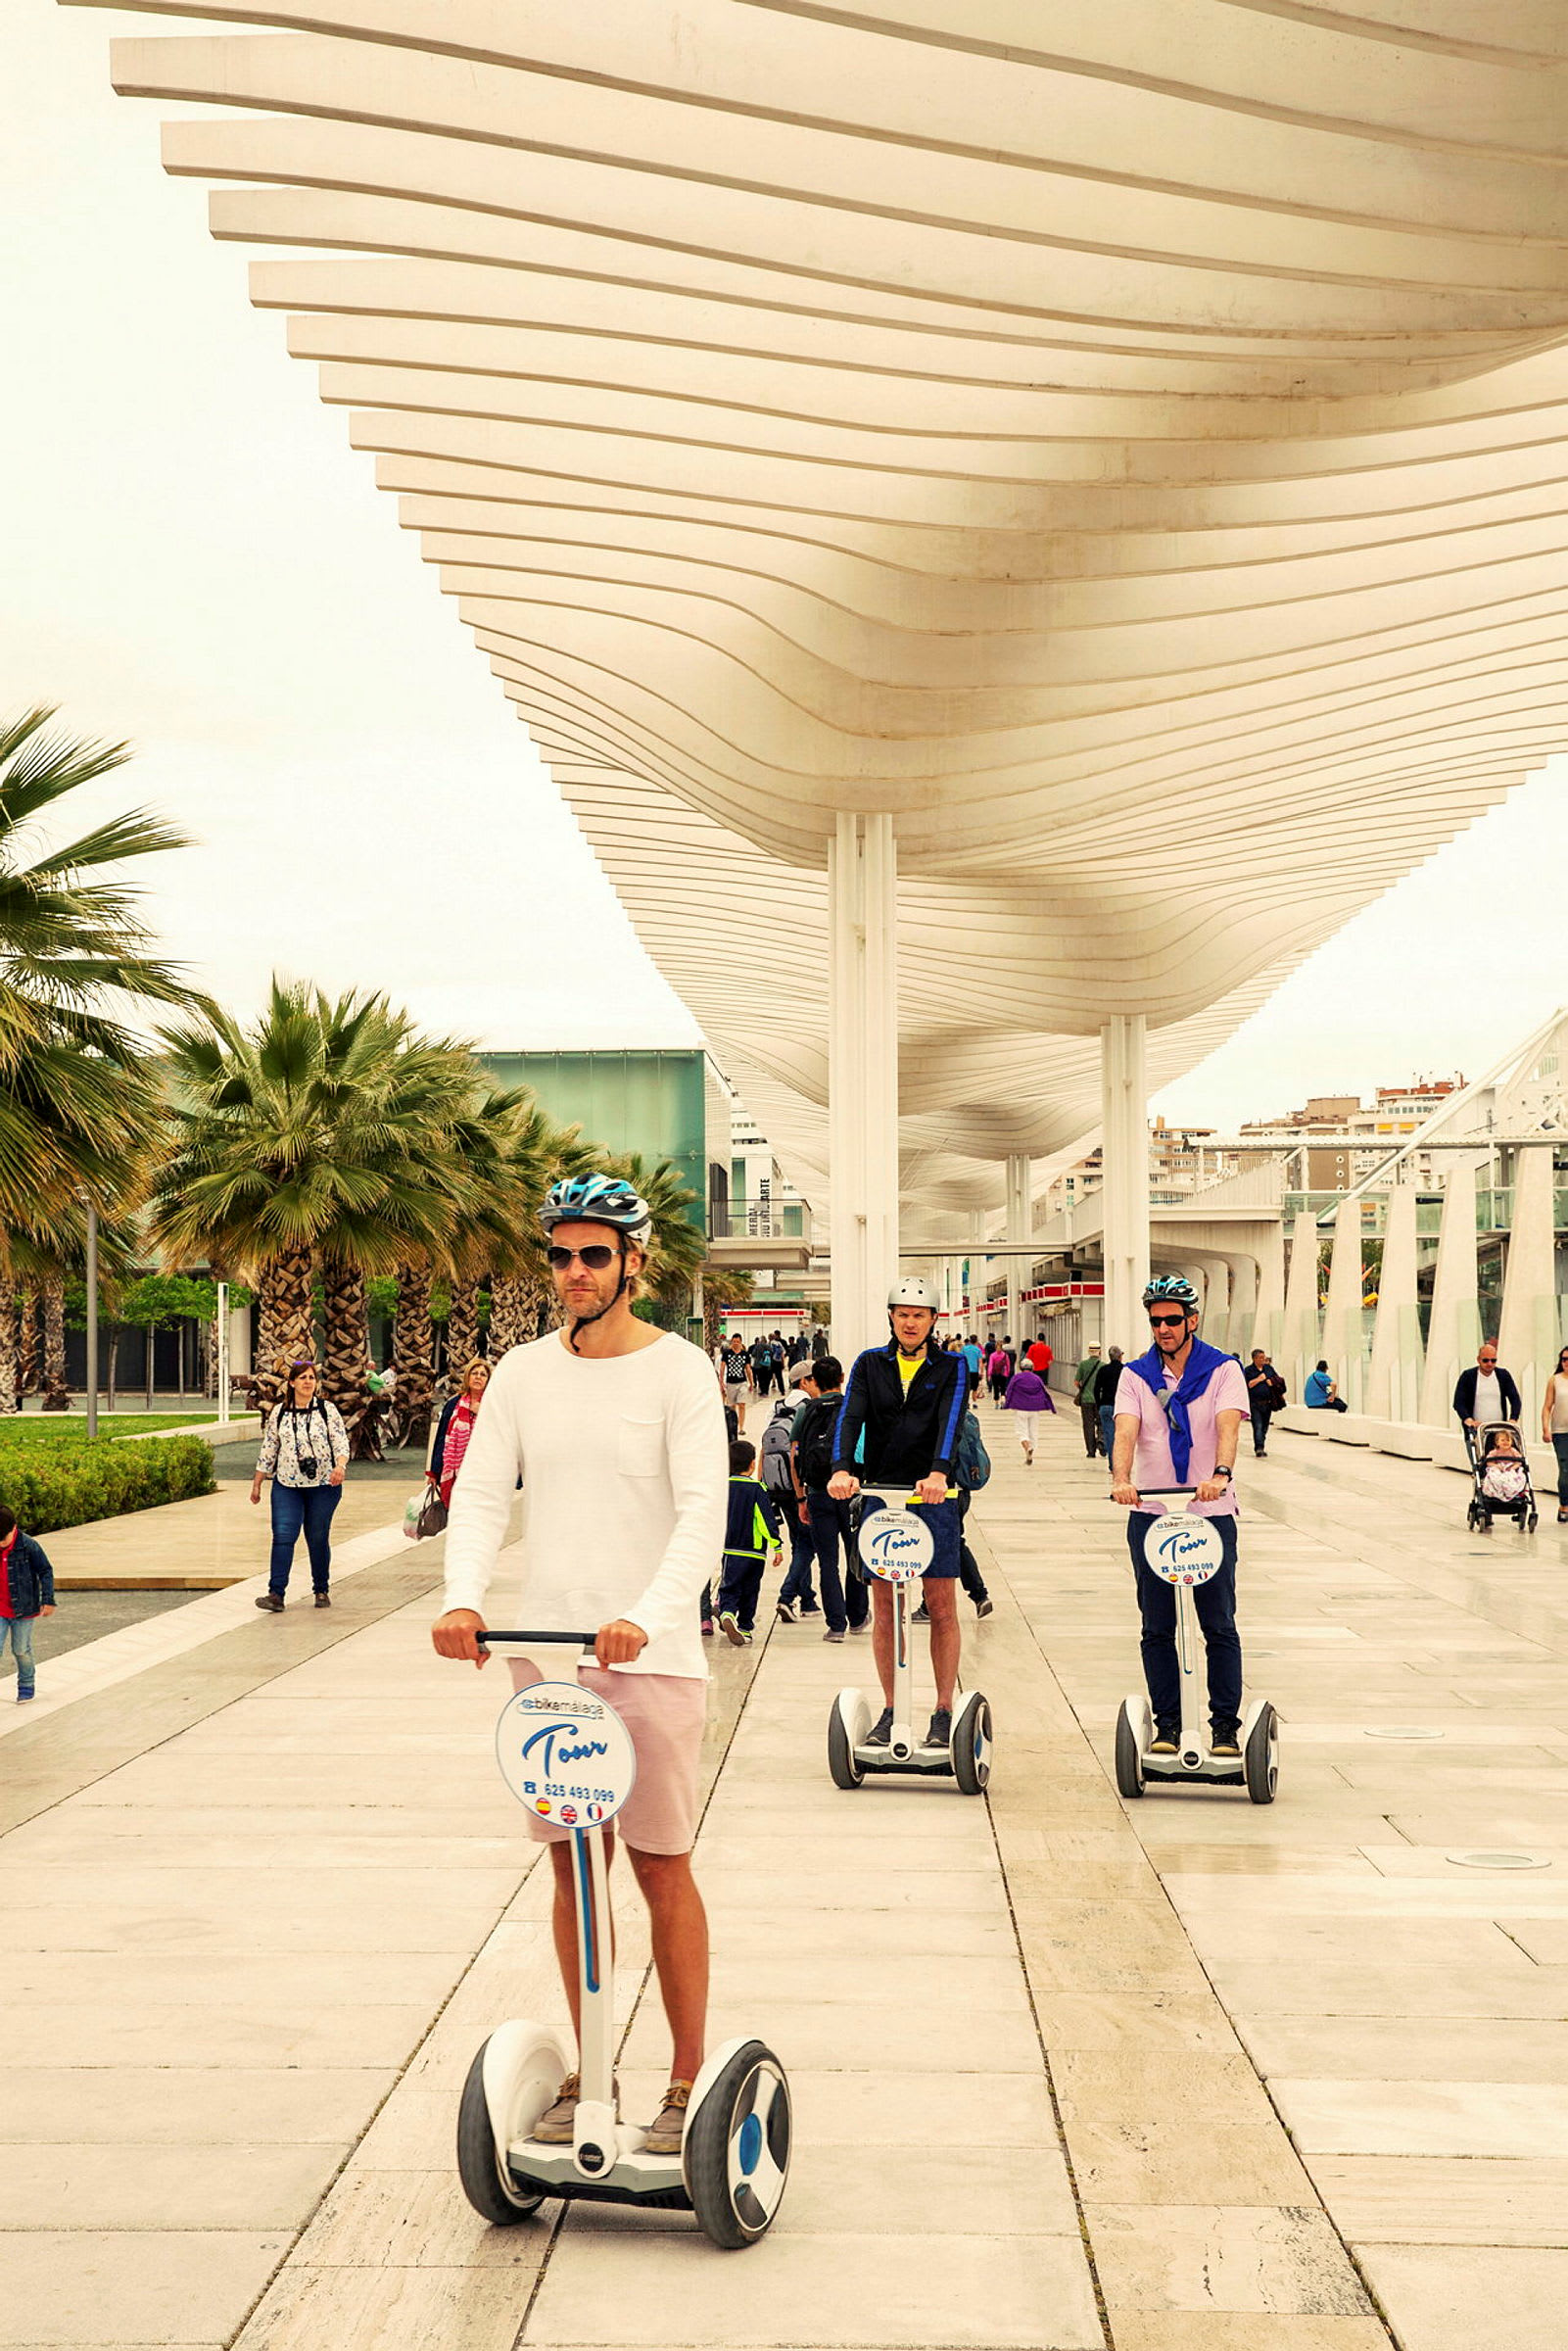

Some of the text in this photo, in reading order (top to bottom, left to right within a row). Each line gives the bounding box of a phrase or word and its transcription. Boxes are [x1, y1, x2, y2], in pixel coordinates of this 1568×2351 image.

[872, 1529, 920, 1558] Tour
[1159, 1532, 1208, 1563] Tour
[521, 1723, 608, 1778] Tour
[545, 1783, 614, 1802] 625 493 099
